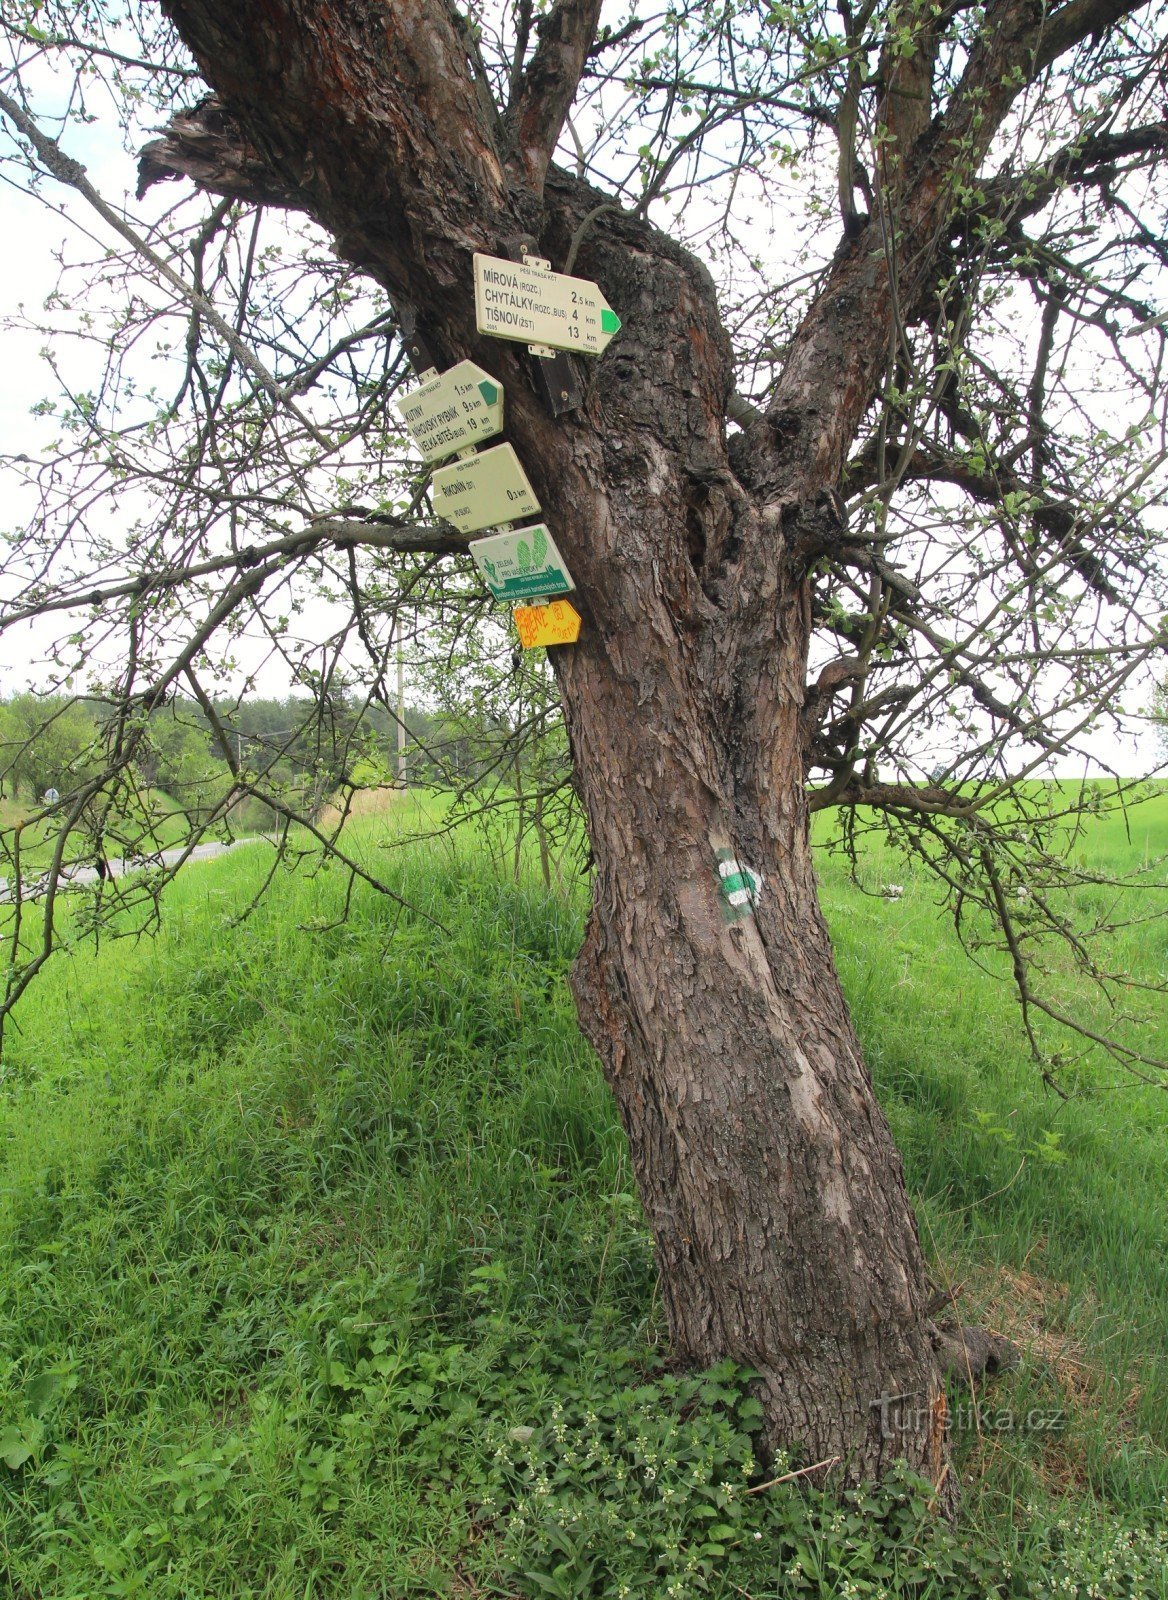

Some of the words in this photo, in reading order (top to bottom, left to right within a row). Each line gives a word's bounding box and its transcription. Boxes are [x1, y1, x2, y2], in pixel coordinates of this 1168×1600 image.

[483, 268, 518, 289] MÍROVÁ
[520, 282, 541, 296] (ROZC.)
[585, 298, 595, 306] km
[532, 271, 547, 279] TRASA
[485, 289, 533, 310] CHYTÁLKY
[572, 310, 578, 321] 4
[586, 316, 595, 324] km
[485, 307, 518, 325] TIŠNOV
[568, 326, 579, 338] 13
[587, 333, 596, 342] km
[405, 405, 424, 423] KUTINY
[437, 405, 459, 425] RYBNÍK
[472, 400, 481, 408] km
[419, 437, 439, 452] VELKÁ
[436, 427, 454, 444] BÍTEŠ
[467, 418, 477, 430] 19
[441, 480, 466, 497] ŘIKONÍN
[507, 490, 518, 500] 0,3
[496, 558, 513, 568] ZELENÁ
